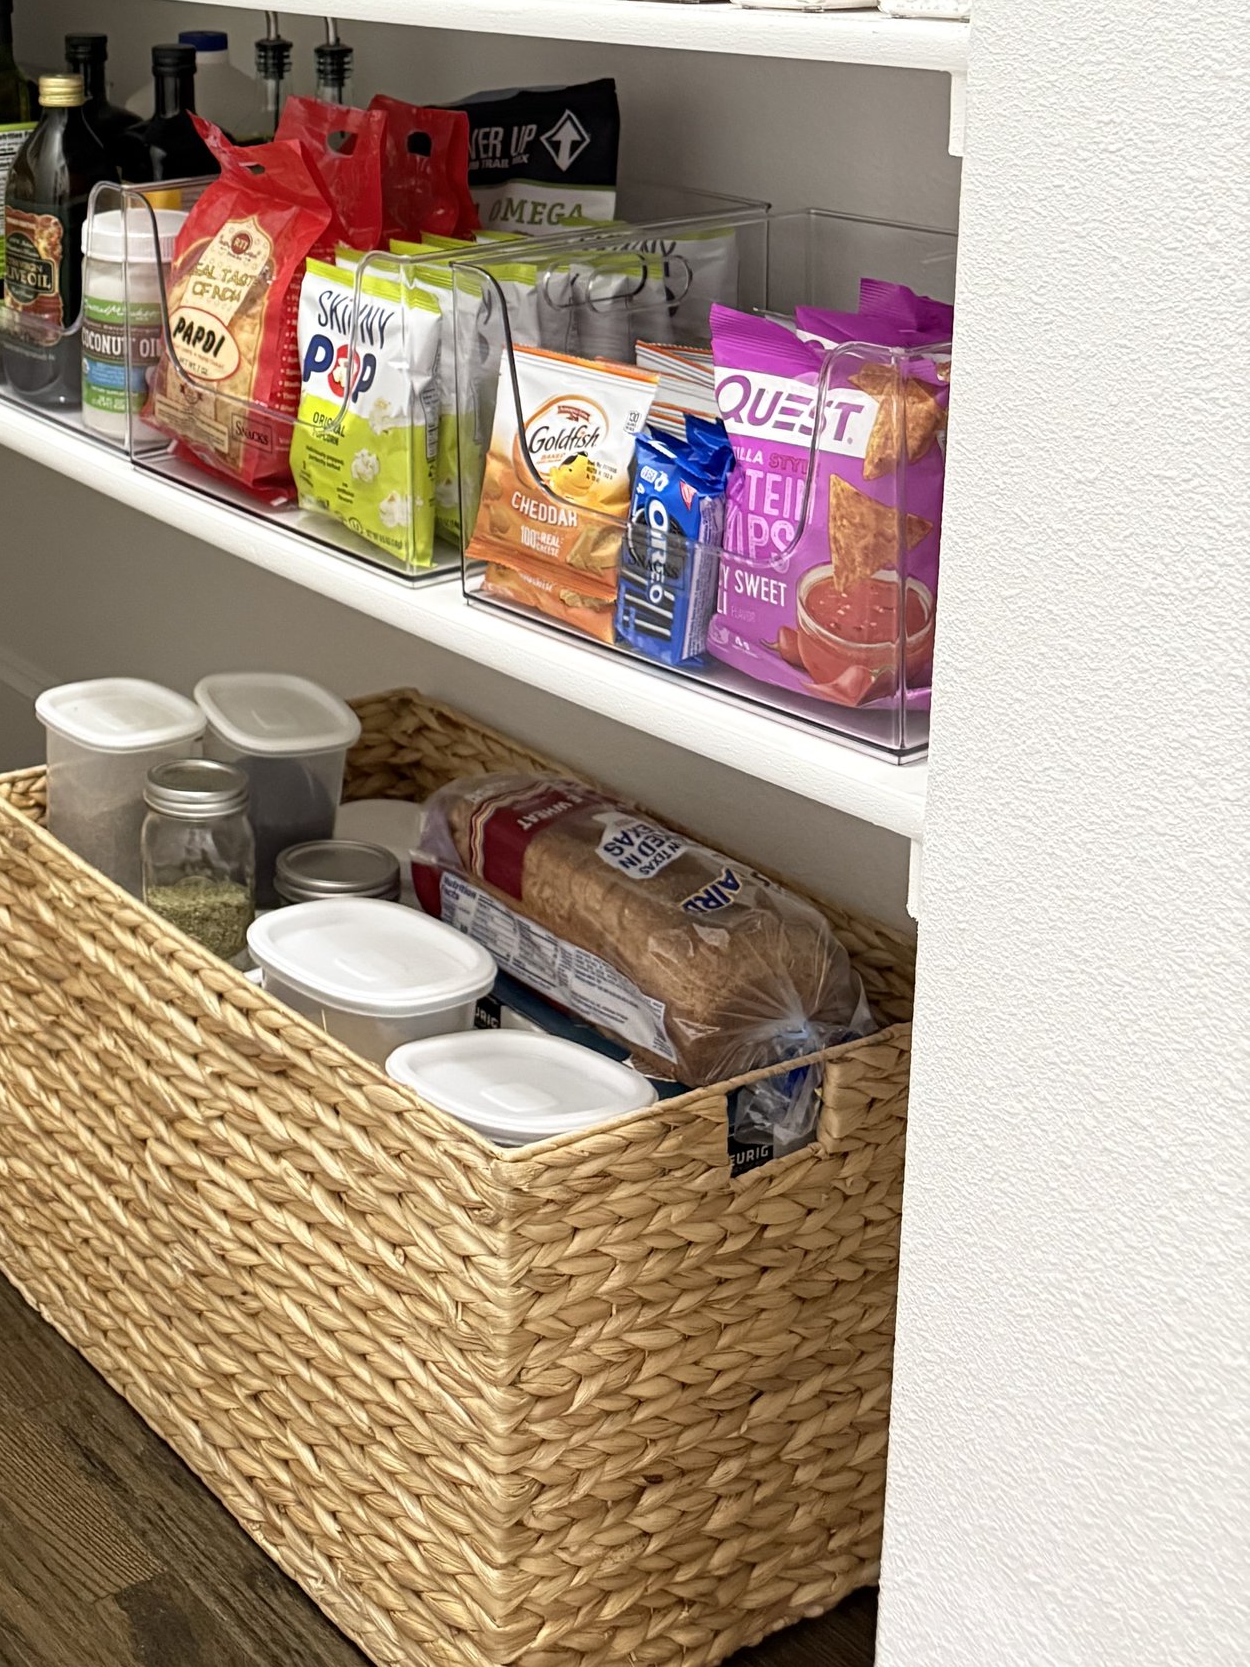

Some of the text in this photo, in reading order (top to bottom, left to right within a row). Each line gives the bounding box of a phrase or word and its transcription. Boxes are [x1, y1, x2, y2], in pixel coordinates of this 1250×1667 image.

[509, 123, 538, 158] UP
[481, 158, 510, 169] TRAIL
[488, 197, 584, 226] OMEGA
[6, 267, 52, 290] LIVE OIL
[317, 289, 395, 350] SKINNY
[172, 316, 226, 359] PAPDI
[302, 333, 377, 404] POP
[714, 374, 866, 442] QUEST
[235, 420, 269, 445] SNACKS
[528, 424, 601, 455] Goldfish
[768, 451, 810, 475] STYL
[511, 491, 578, 527] CHEDDAR
[745, 468, 816, 526] TEIN
[648, 498, 670, 604] OREO
[734, 569, 788, 608] SWEET
[516, 800, 573, 831] WHEAT
[603, 822, 653, 857] EXAS
[618, 853, 642, 869] IN
[638, 849, 672, 875] TEXAS
[729, 1144, 769, 1167] EURIG
